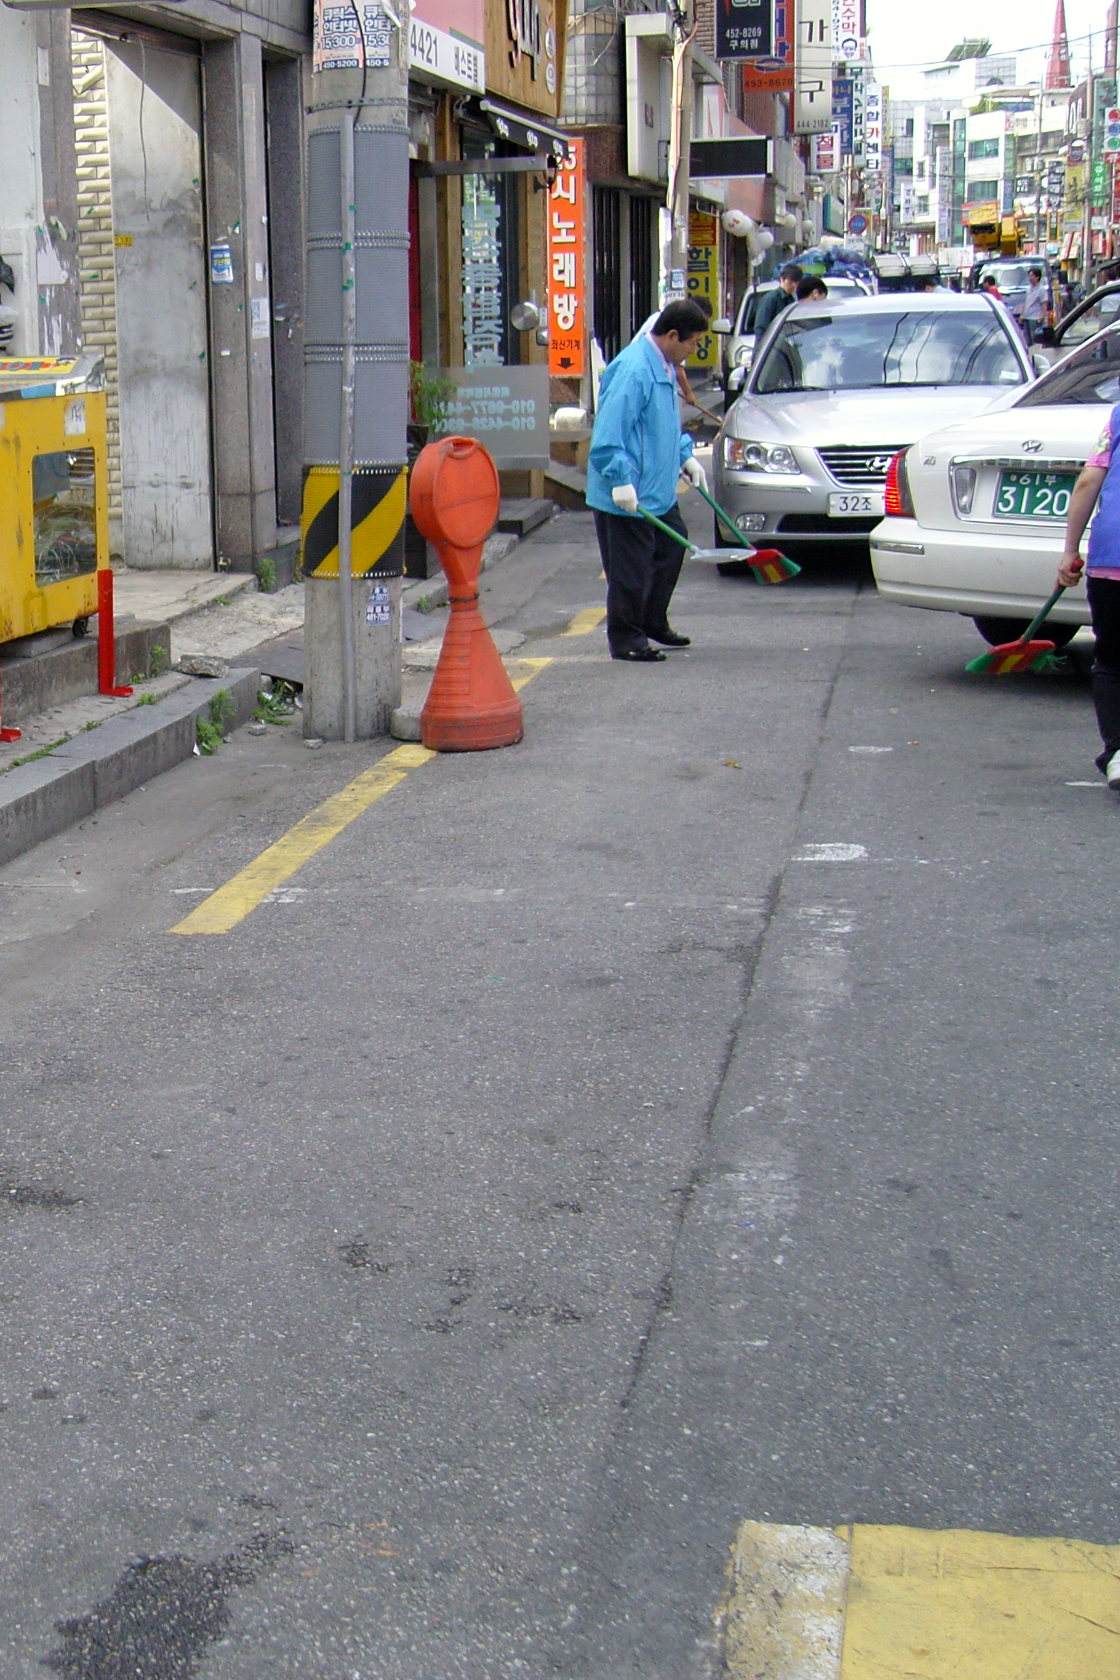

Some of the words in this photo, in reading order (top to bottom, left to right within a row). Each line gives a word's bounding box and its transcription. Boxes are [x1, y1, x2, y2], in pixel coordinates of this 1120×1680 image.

[323, 21, 358, 35] 인터넷
[410, 24, 438, 67] 4421
[551, 339, 580, 351] 최신기계
[839, 495, 872, 511] 32조
[998, 486, 1072, 516] 3120
